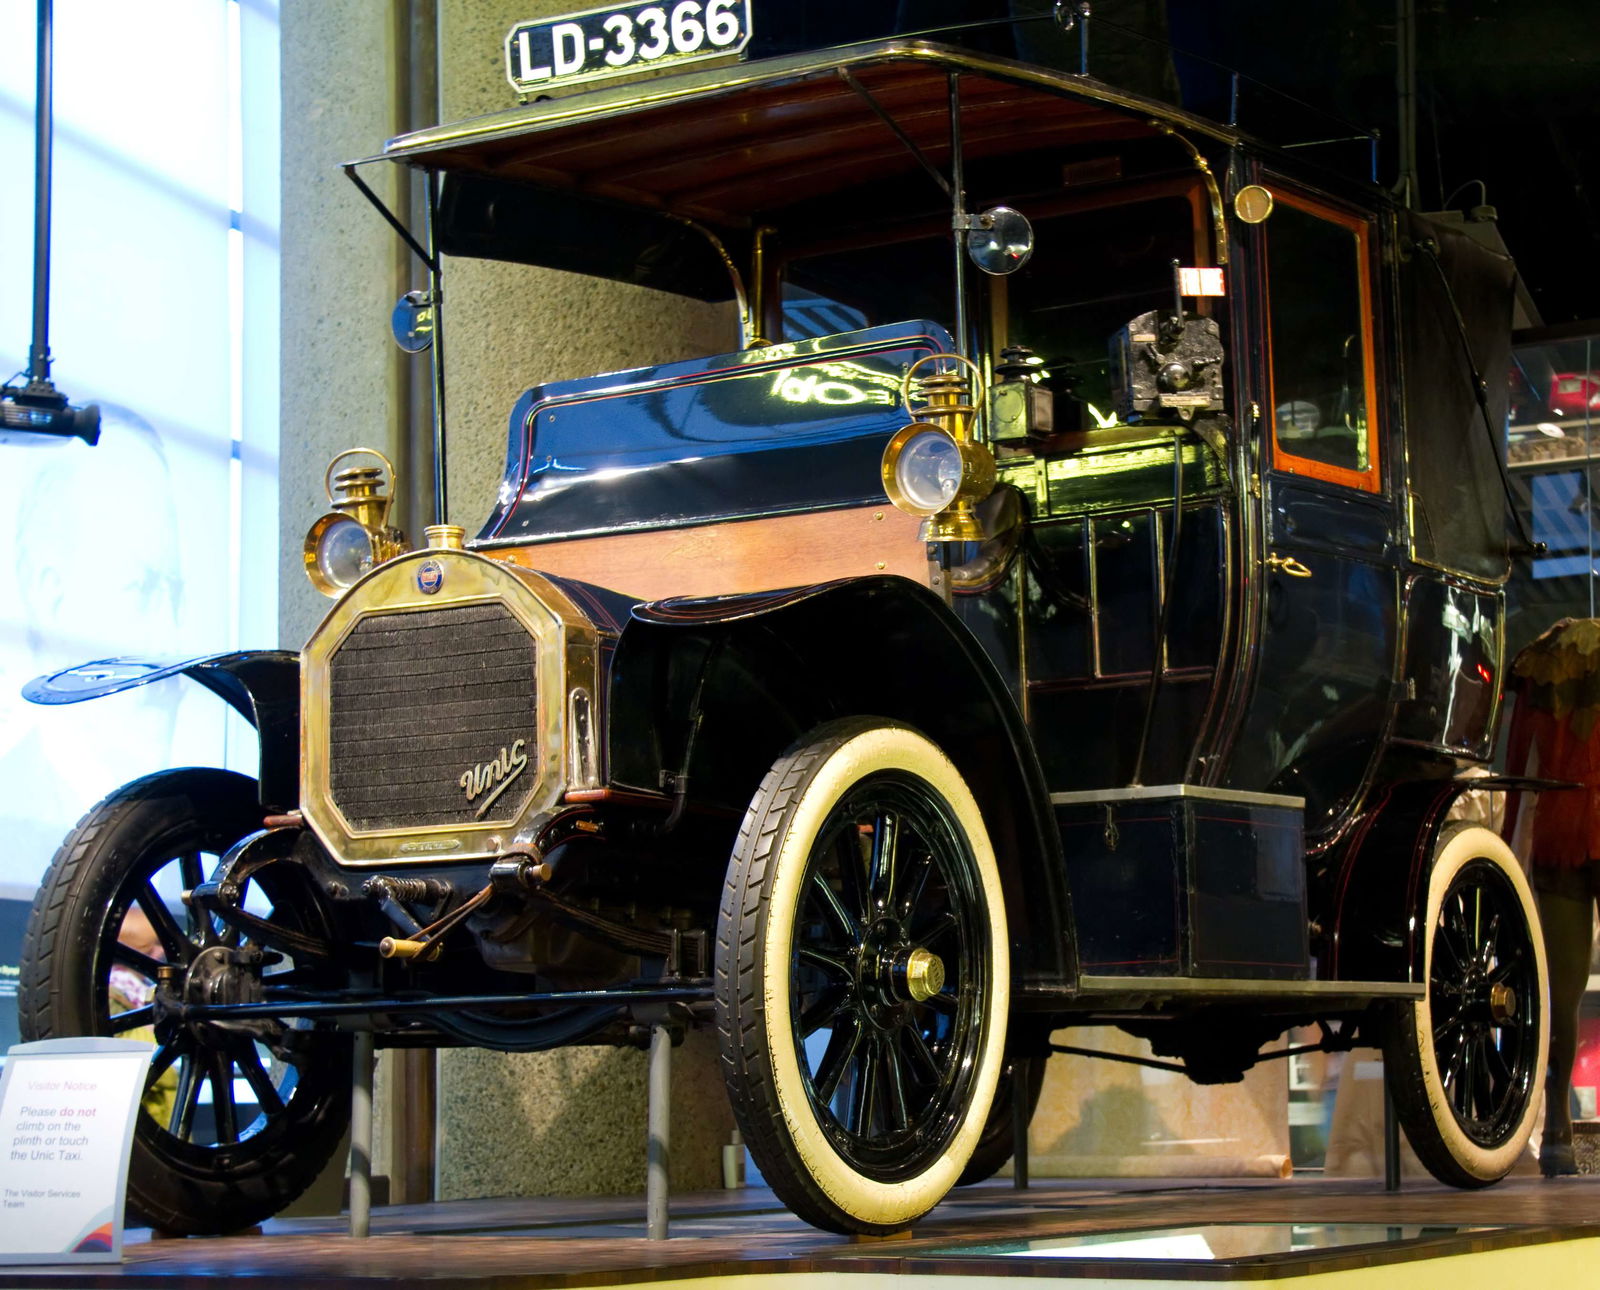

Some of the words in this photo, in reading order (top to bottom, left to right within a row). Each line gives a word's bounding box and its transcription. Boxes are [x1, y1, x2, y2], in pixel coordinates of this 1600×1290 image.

[518, 0, 740, 82] LD-3366
[28, 1081, 60, 1091] Visitor
[63, 1081, 97, 1091] Notice
[20, 1106, 57, 1117] Please
[59, 1106, 74, 1117] do
[77, 1107, 97, 1117] not
[16, 1121, 45, 1131] climb
[64, 1121, 81, 1131] the
[13, 1135, 42, 1147] plinth
[45, 1138, 56, 1146] or
[59, 1135, 88, 1146] touch
[10, 1150, 28, 1160] the
[30, 1150, 55, 1160] Unic
[59, 1150, 83, 1160] Taxi.
[5, 1189, 19, 1198] The
[21, 1189, 46, 1198] Visitor
[48, 1189, 81, 1198] Services
[3, 1200, 25, 1208] Team
